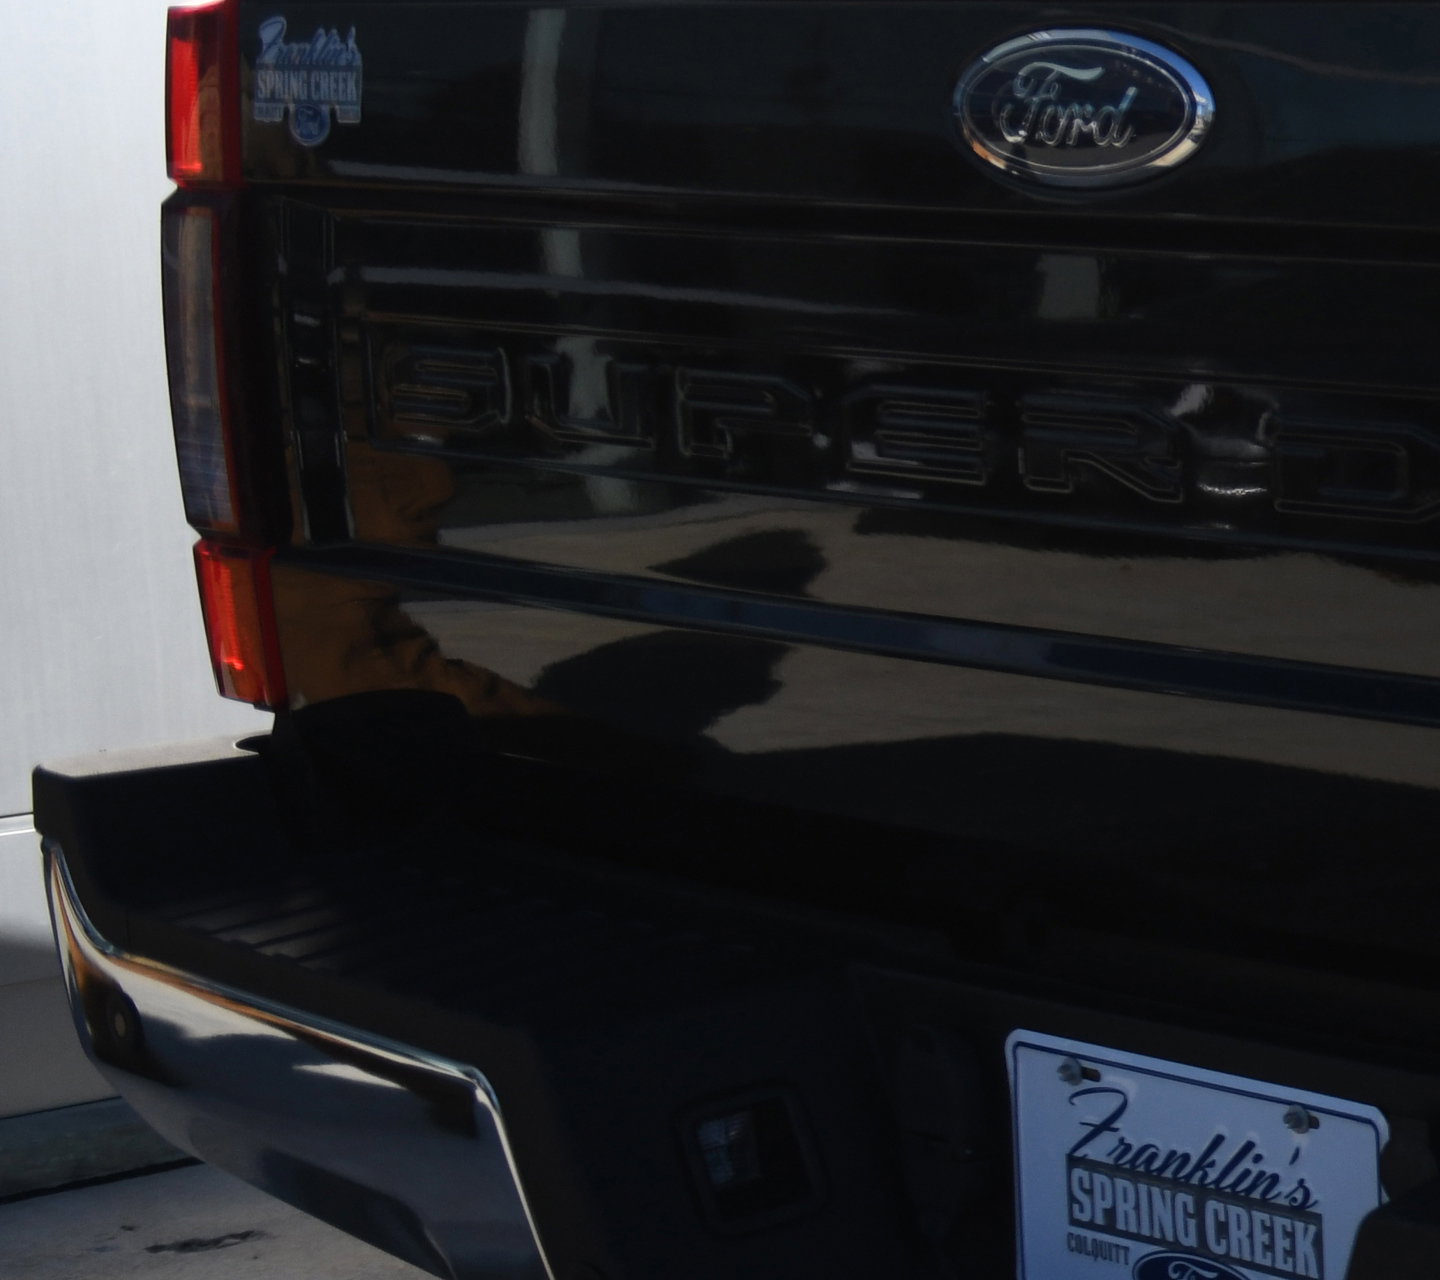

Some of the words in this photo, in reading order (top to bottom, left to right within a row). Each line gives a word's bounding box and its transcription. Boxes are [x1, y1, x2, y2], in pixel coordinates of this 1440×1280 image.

[257, 69, 308, 100] SPRING
[310, 71, 357, 101] CREEK
[993, 61, 1138, 149] Ford
[380, 342, 1184, 506] SUPER
[1067, 1086, 1319, 1210] Franklin's
[1067, 1231, 1131, 1266] COLQUITT
[1071, 1166, 1198, 1248] SPRING
[1204, 1199, 1320, 1280] CREEK
